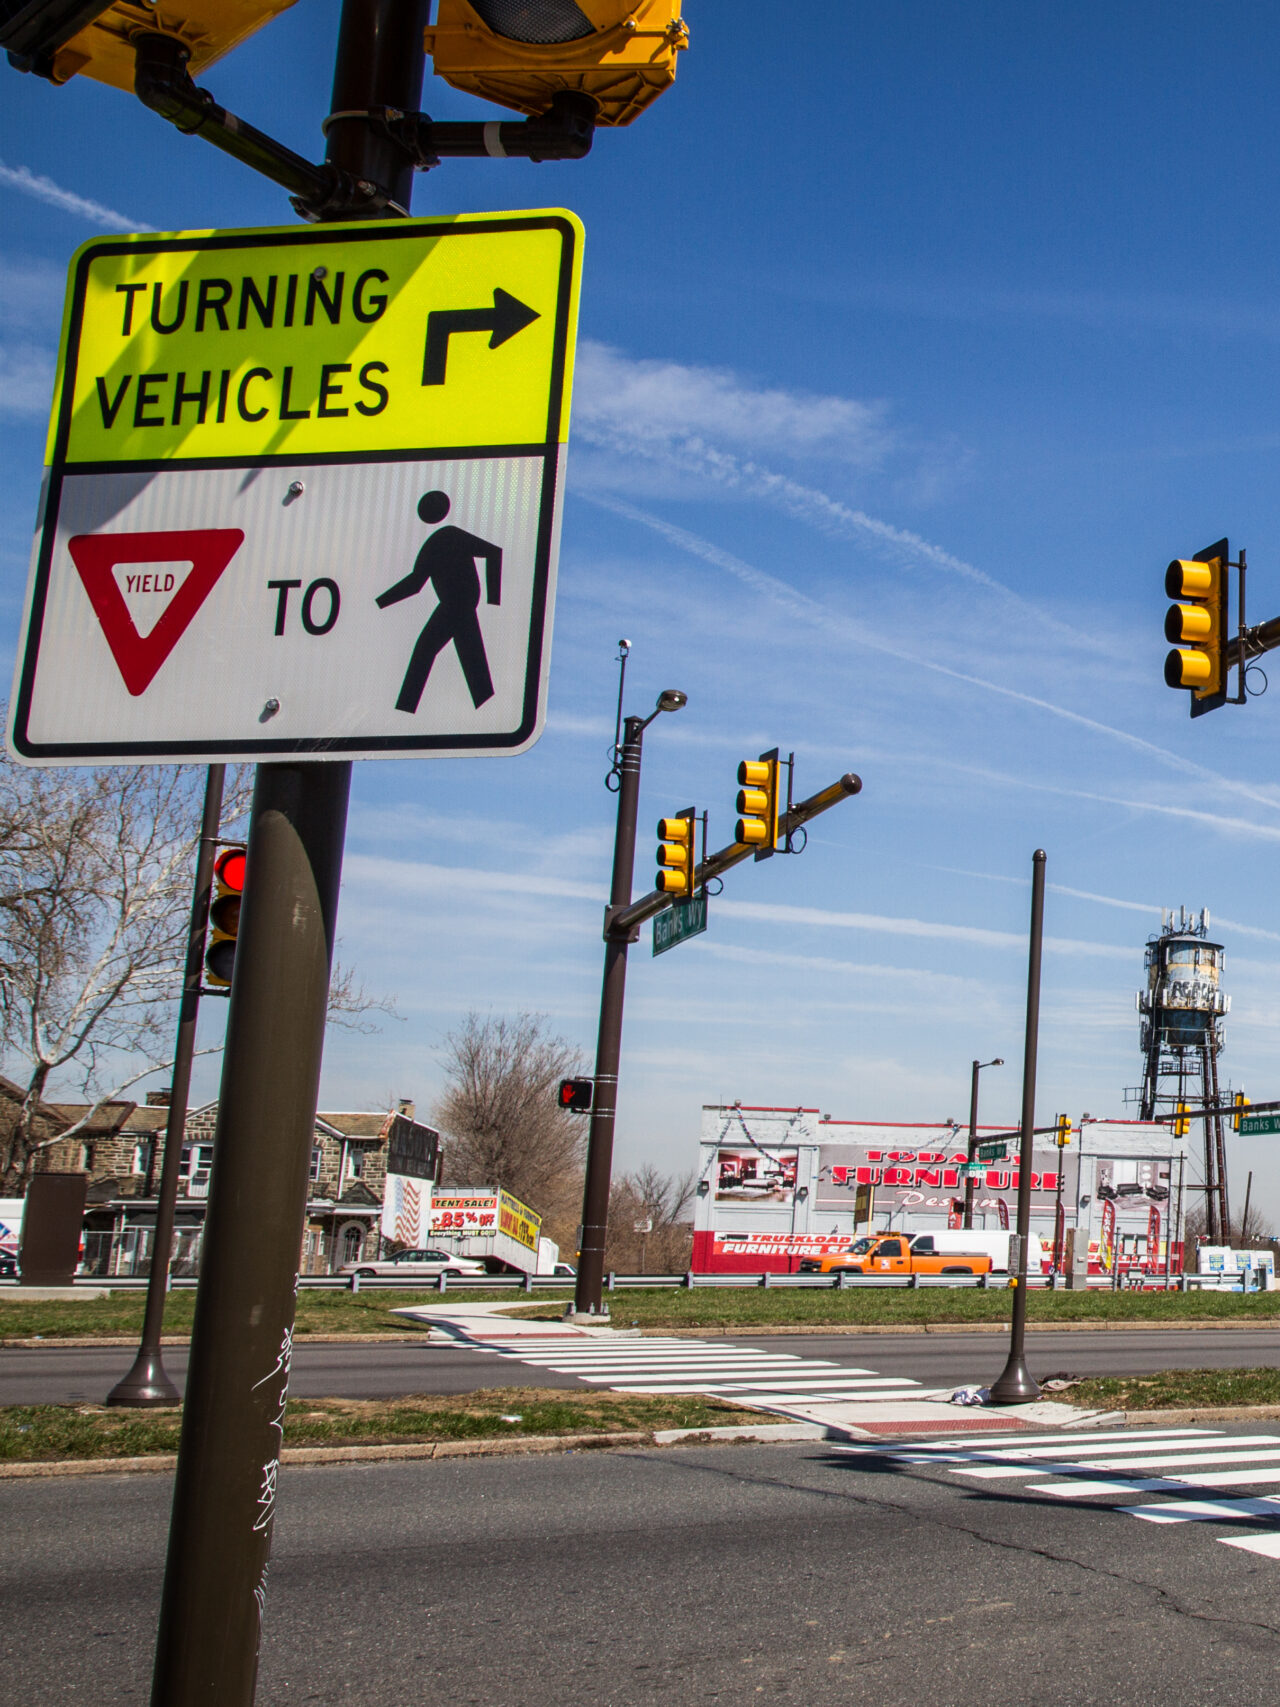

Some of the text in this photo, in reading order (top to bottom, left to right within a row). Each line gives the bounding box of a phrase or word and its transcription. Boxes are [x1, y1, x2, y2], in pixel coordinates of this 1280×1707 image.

[116, 268, 390, 337] TURNING
[96, 361, 390, 429] VEHICLES
[126, 573, 174, 593] YIELD
[268, 578, 341, 636] TO
[656, 907, 683, 945] Banks
[1242, 1119, 1269, 1132] Banks
[479, 1214, 495, 1226] OFF
[751, 1234, 851, 1243] TRUCKLOAD
[722, 1243, 821, 1255] FURNITURE
